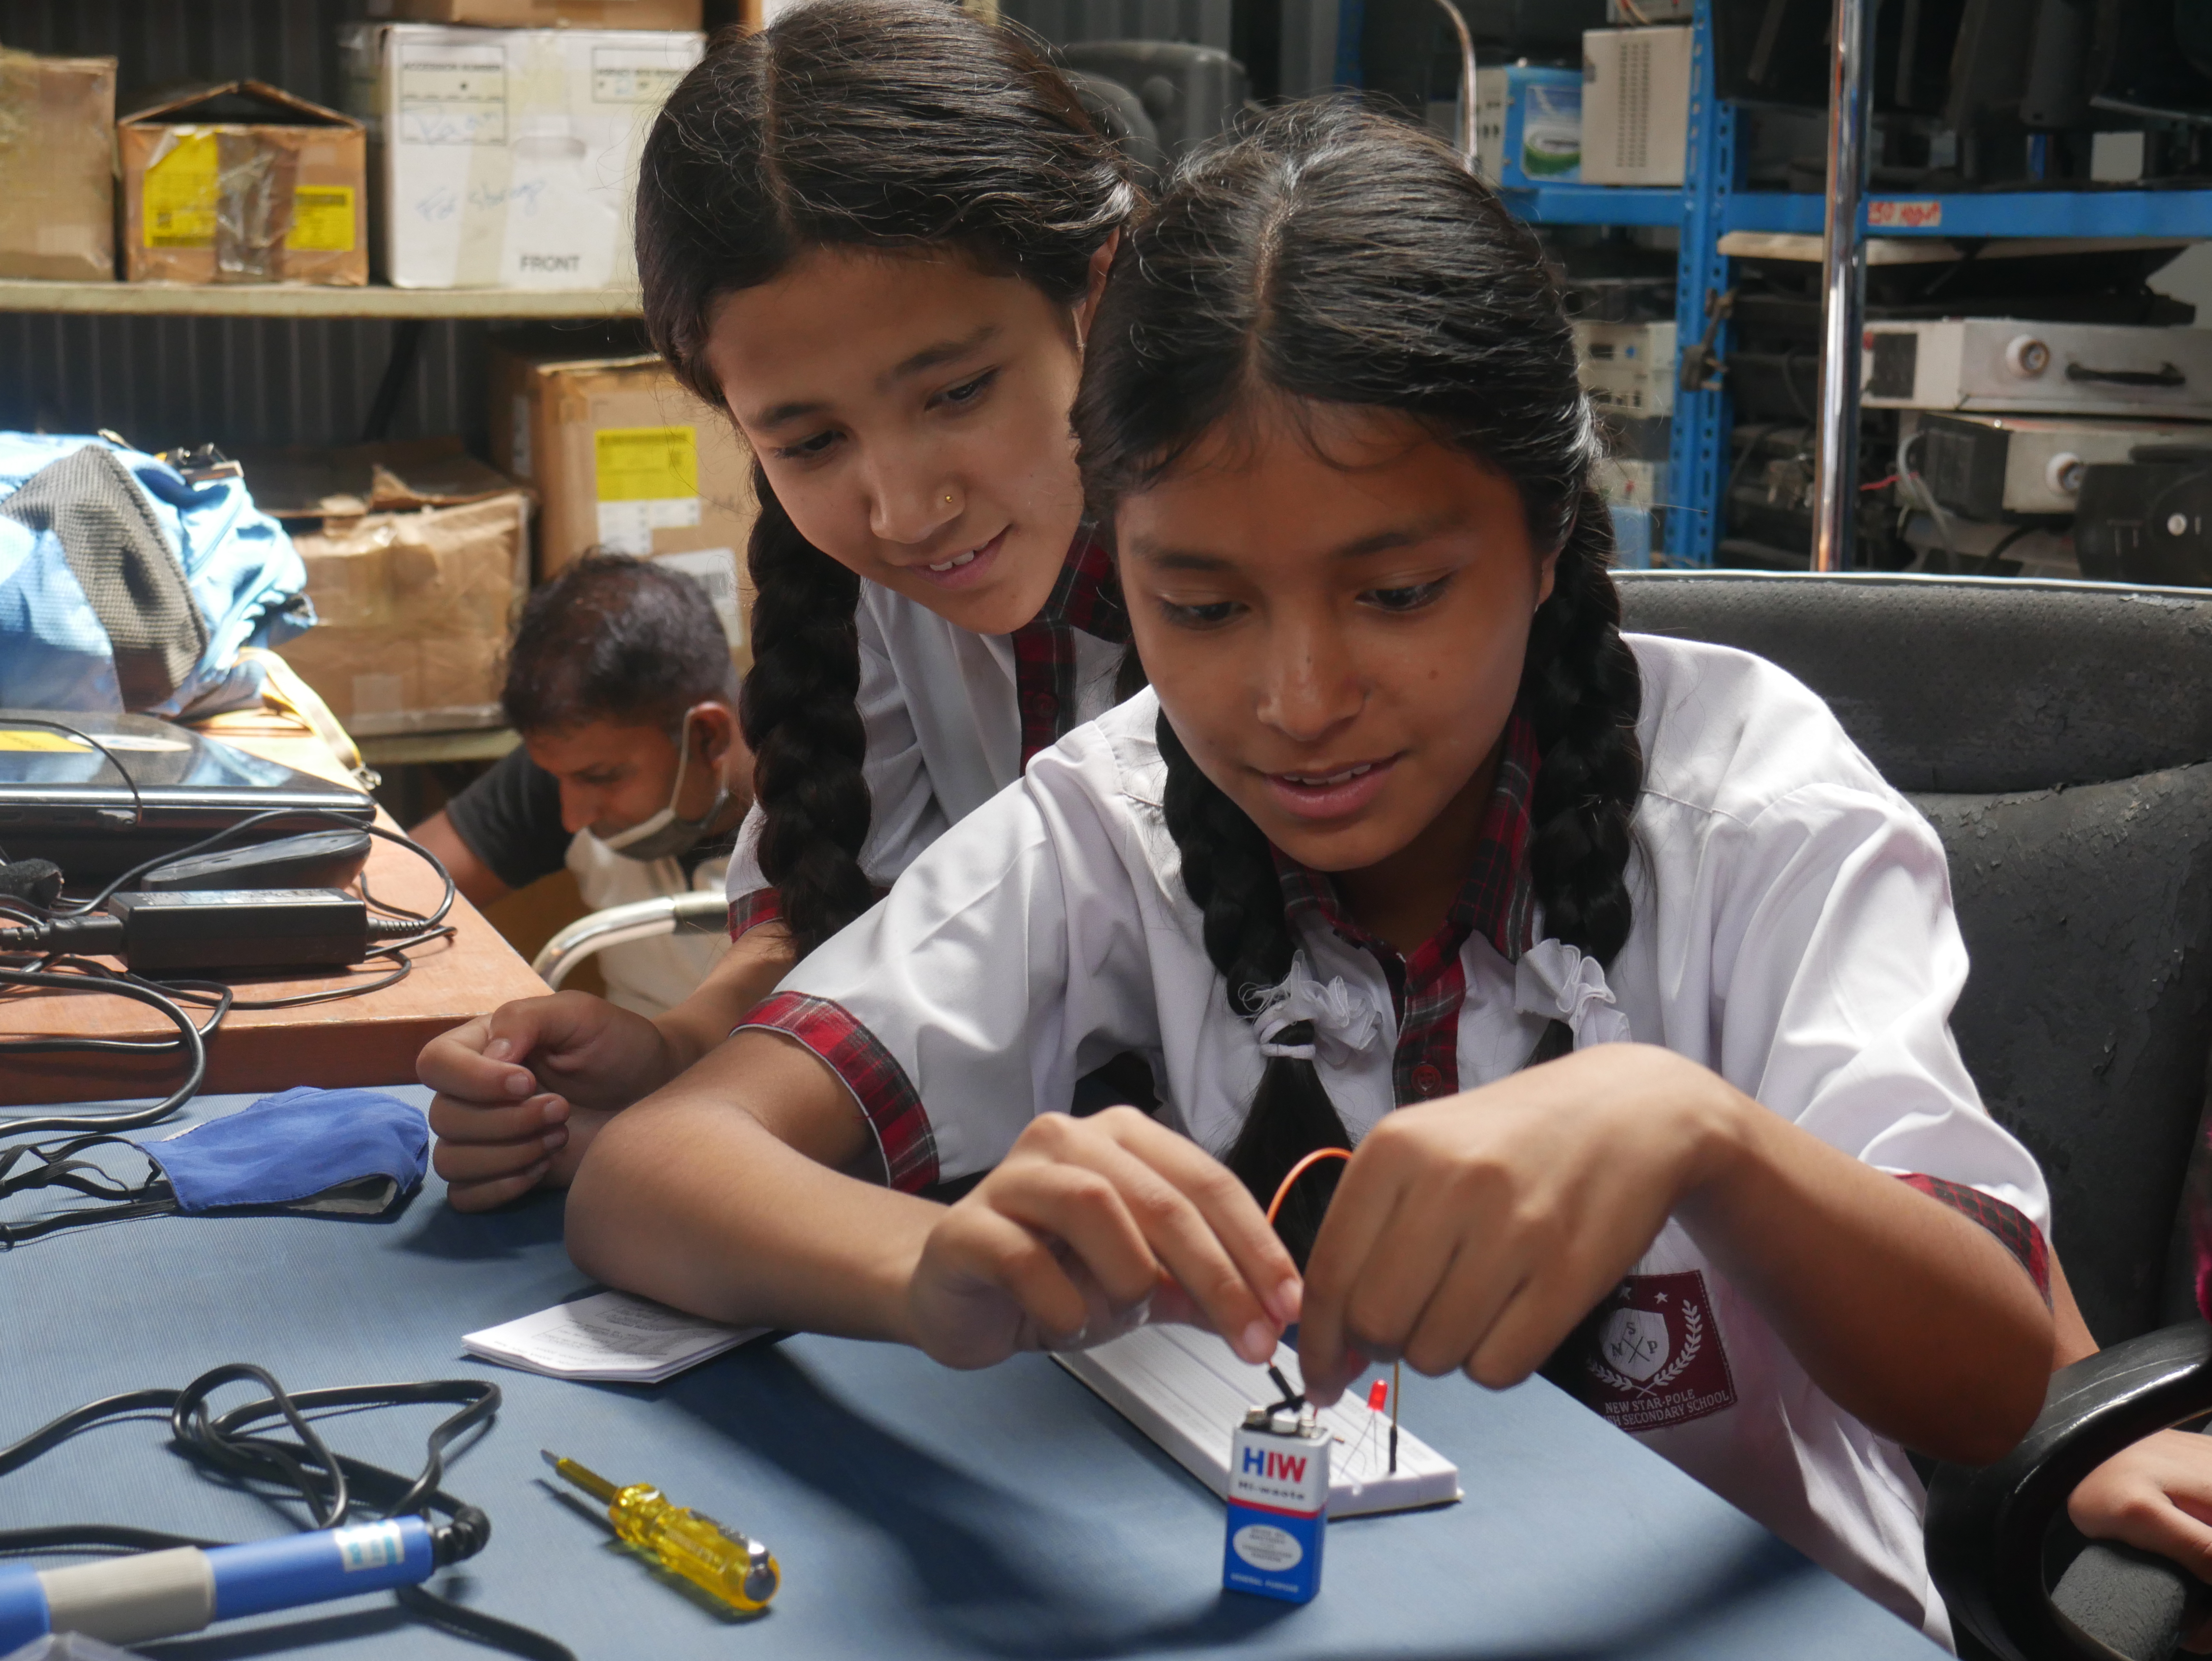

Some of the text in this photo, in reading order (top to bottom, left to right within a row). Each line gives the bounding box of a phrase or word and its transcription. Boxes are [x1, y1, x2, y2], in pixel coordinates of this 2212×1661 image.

[519, 255, 580, 272] FRONT
[1626, 1322, 1636, 1335] S
[1647, 1341, 1658, 1354] P
[1605, 1388, 1695, 1413] NEW STAR-POLE
[1622, 1404, 1685, 1425] SECONDARY
[1687, 1390, 1729, 1413] SCHOOL
[1243, 1445, 1307, 1483] HIW
